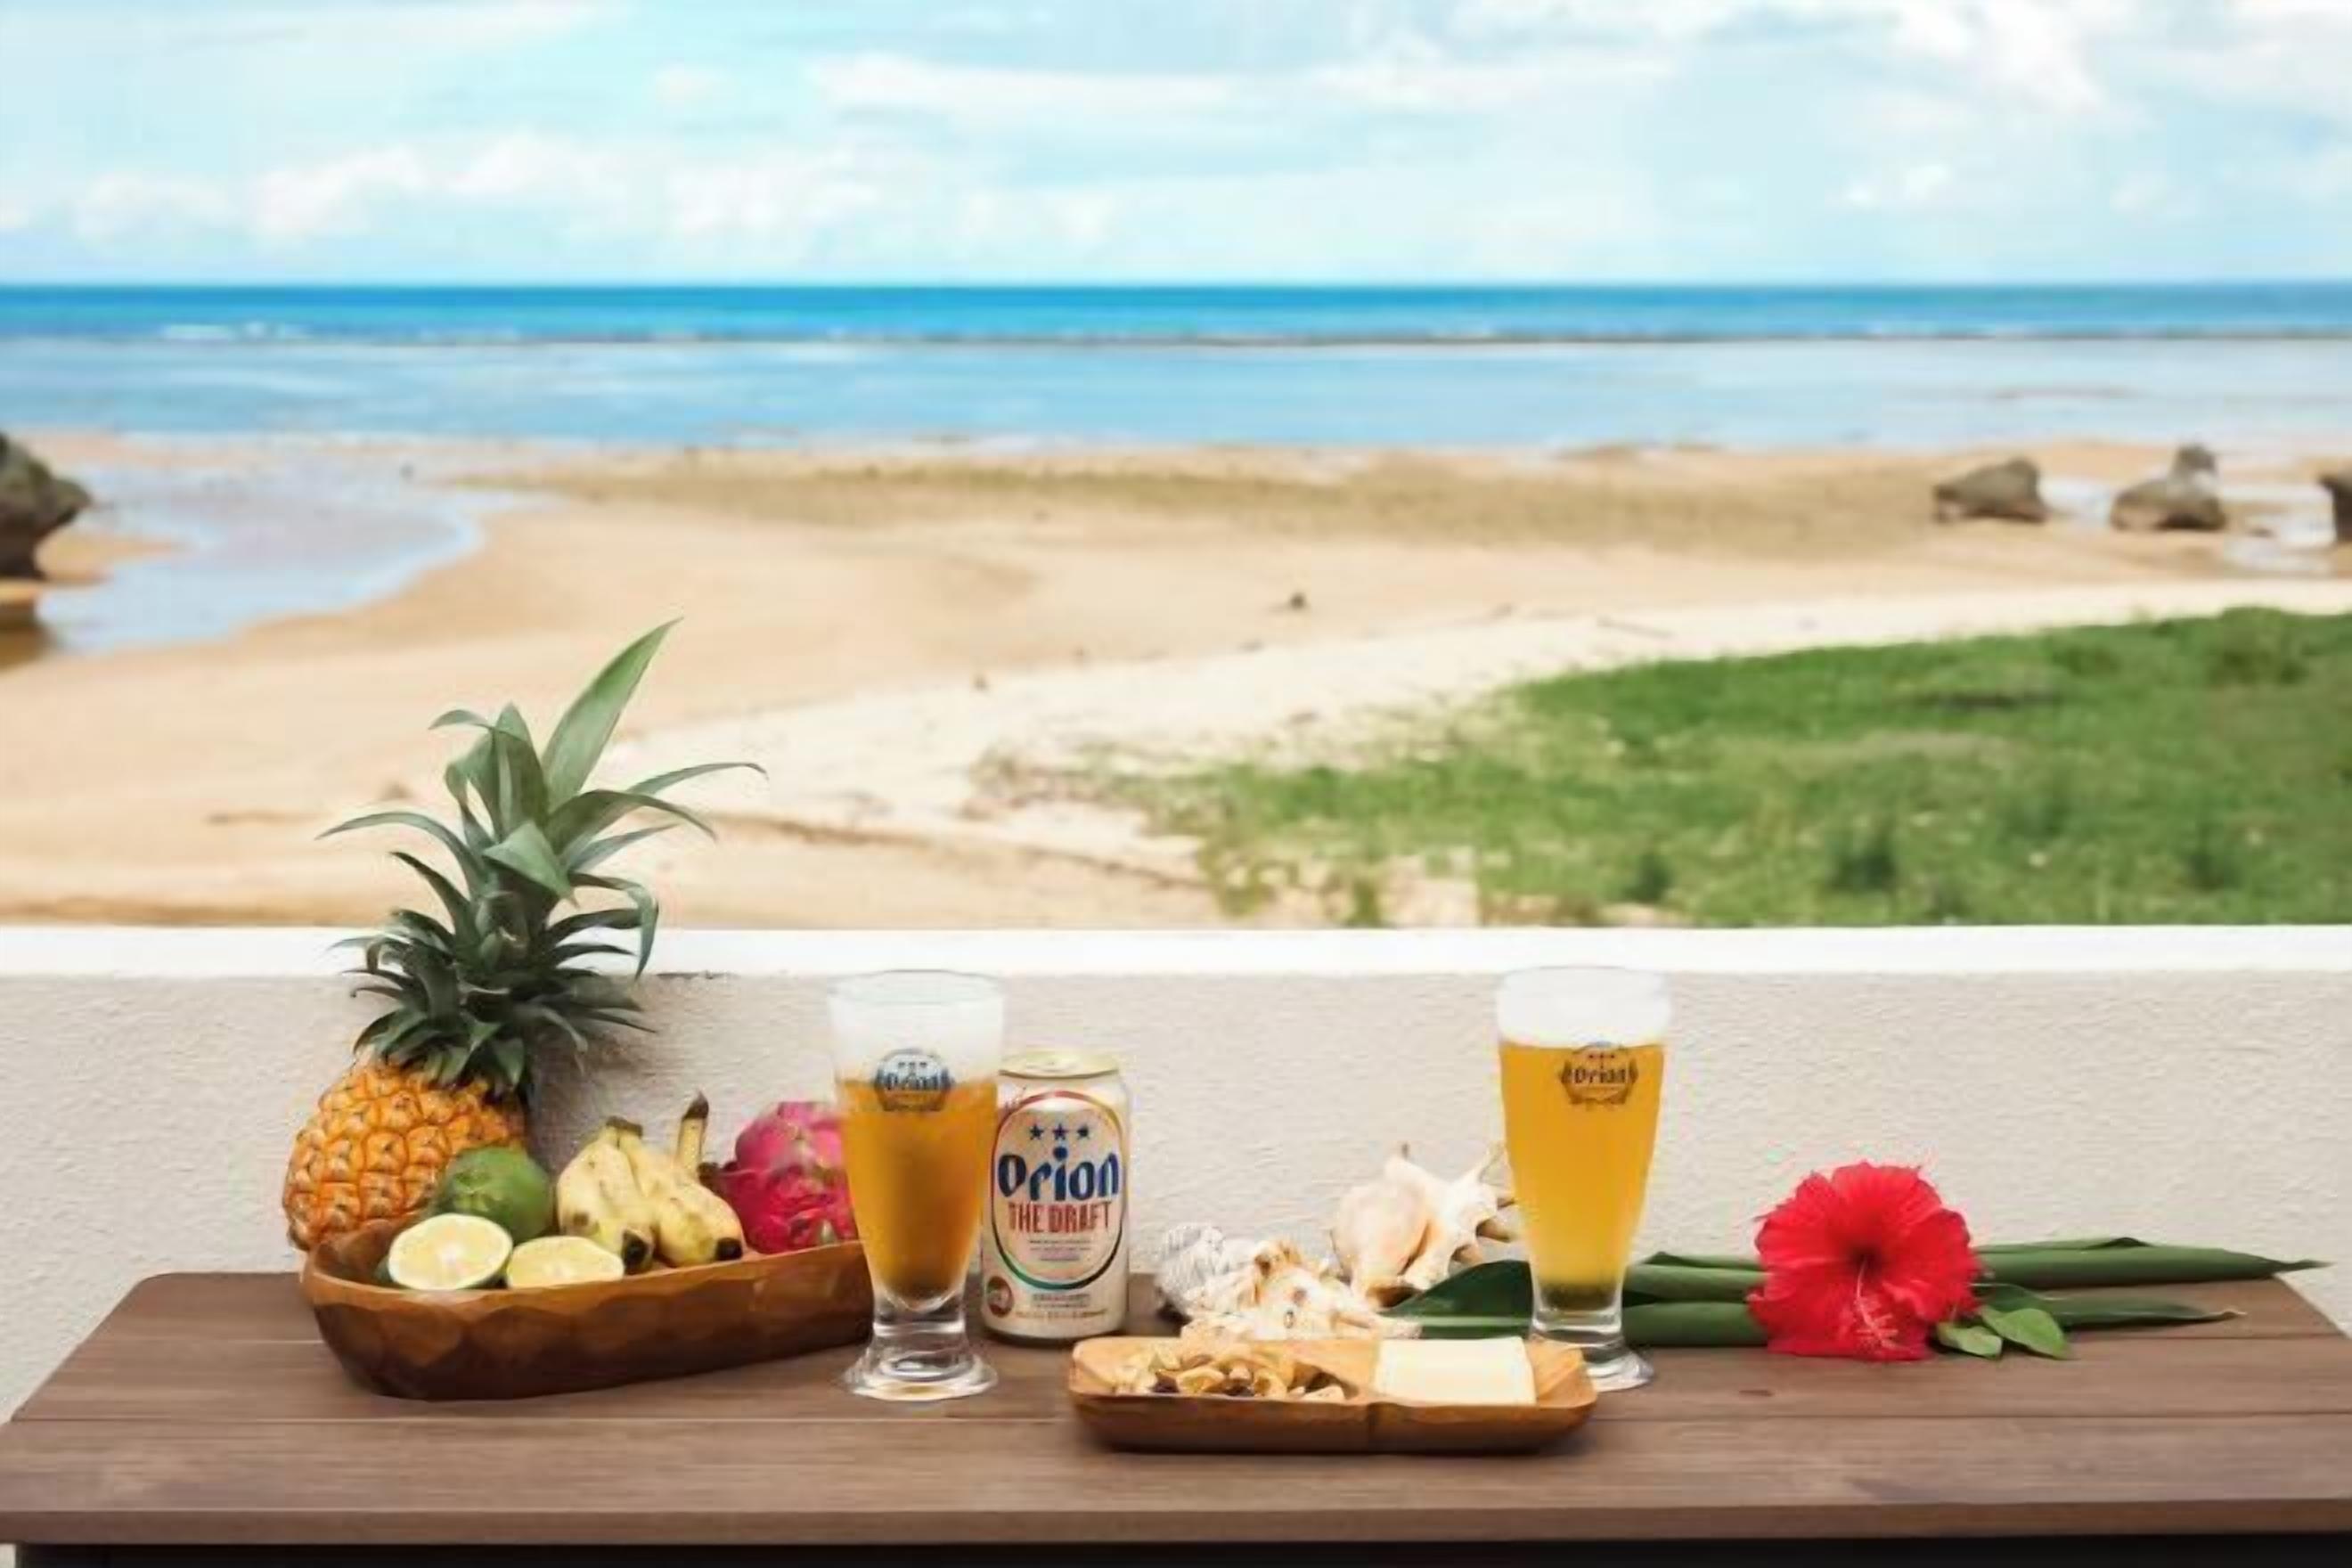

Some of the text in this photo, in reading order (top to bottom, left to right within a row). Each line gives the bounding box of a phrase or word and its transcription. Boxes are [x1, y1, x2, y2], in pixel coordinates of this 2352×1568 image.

[997, 1146, 1120, 1202] Orion
[1008, 1200, 1111, 1233] THE DRAFT
